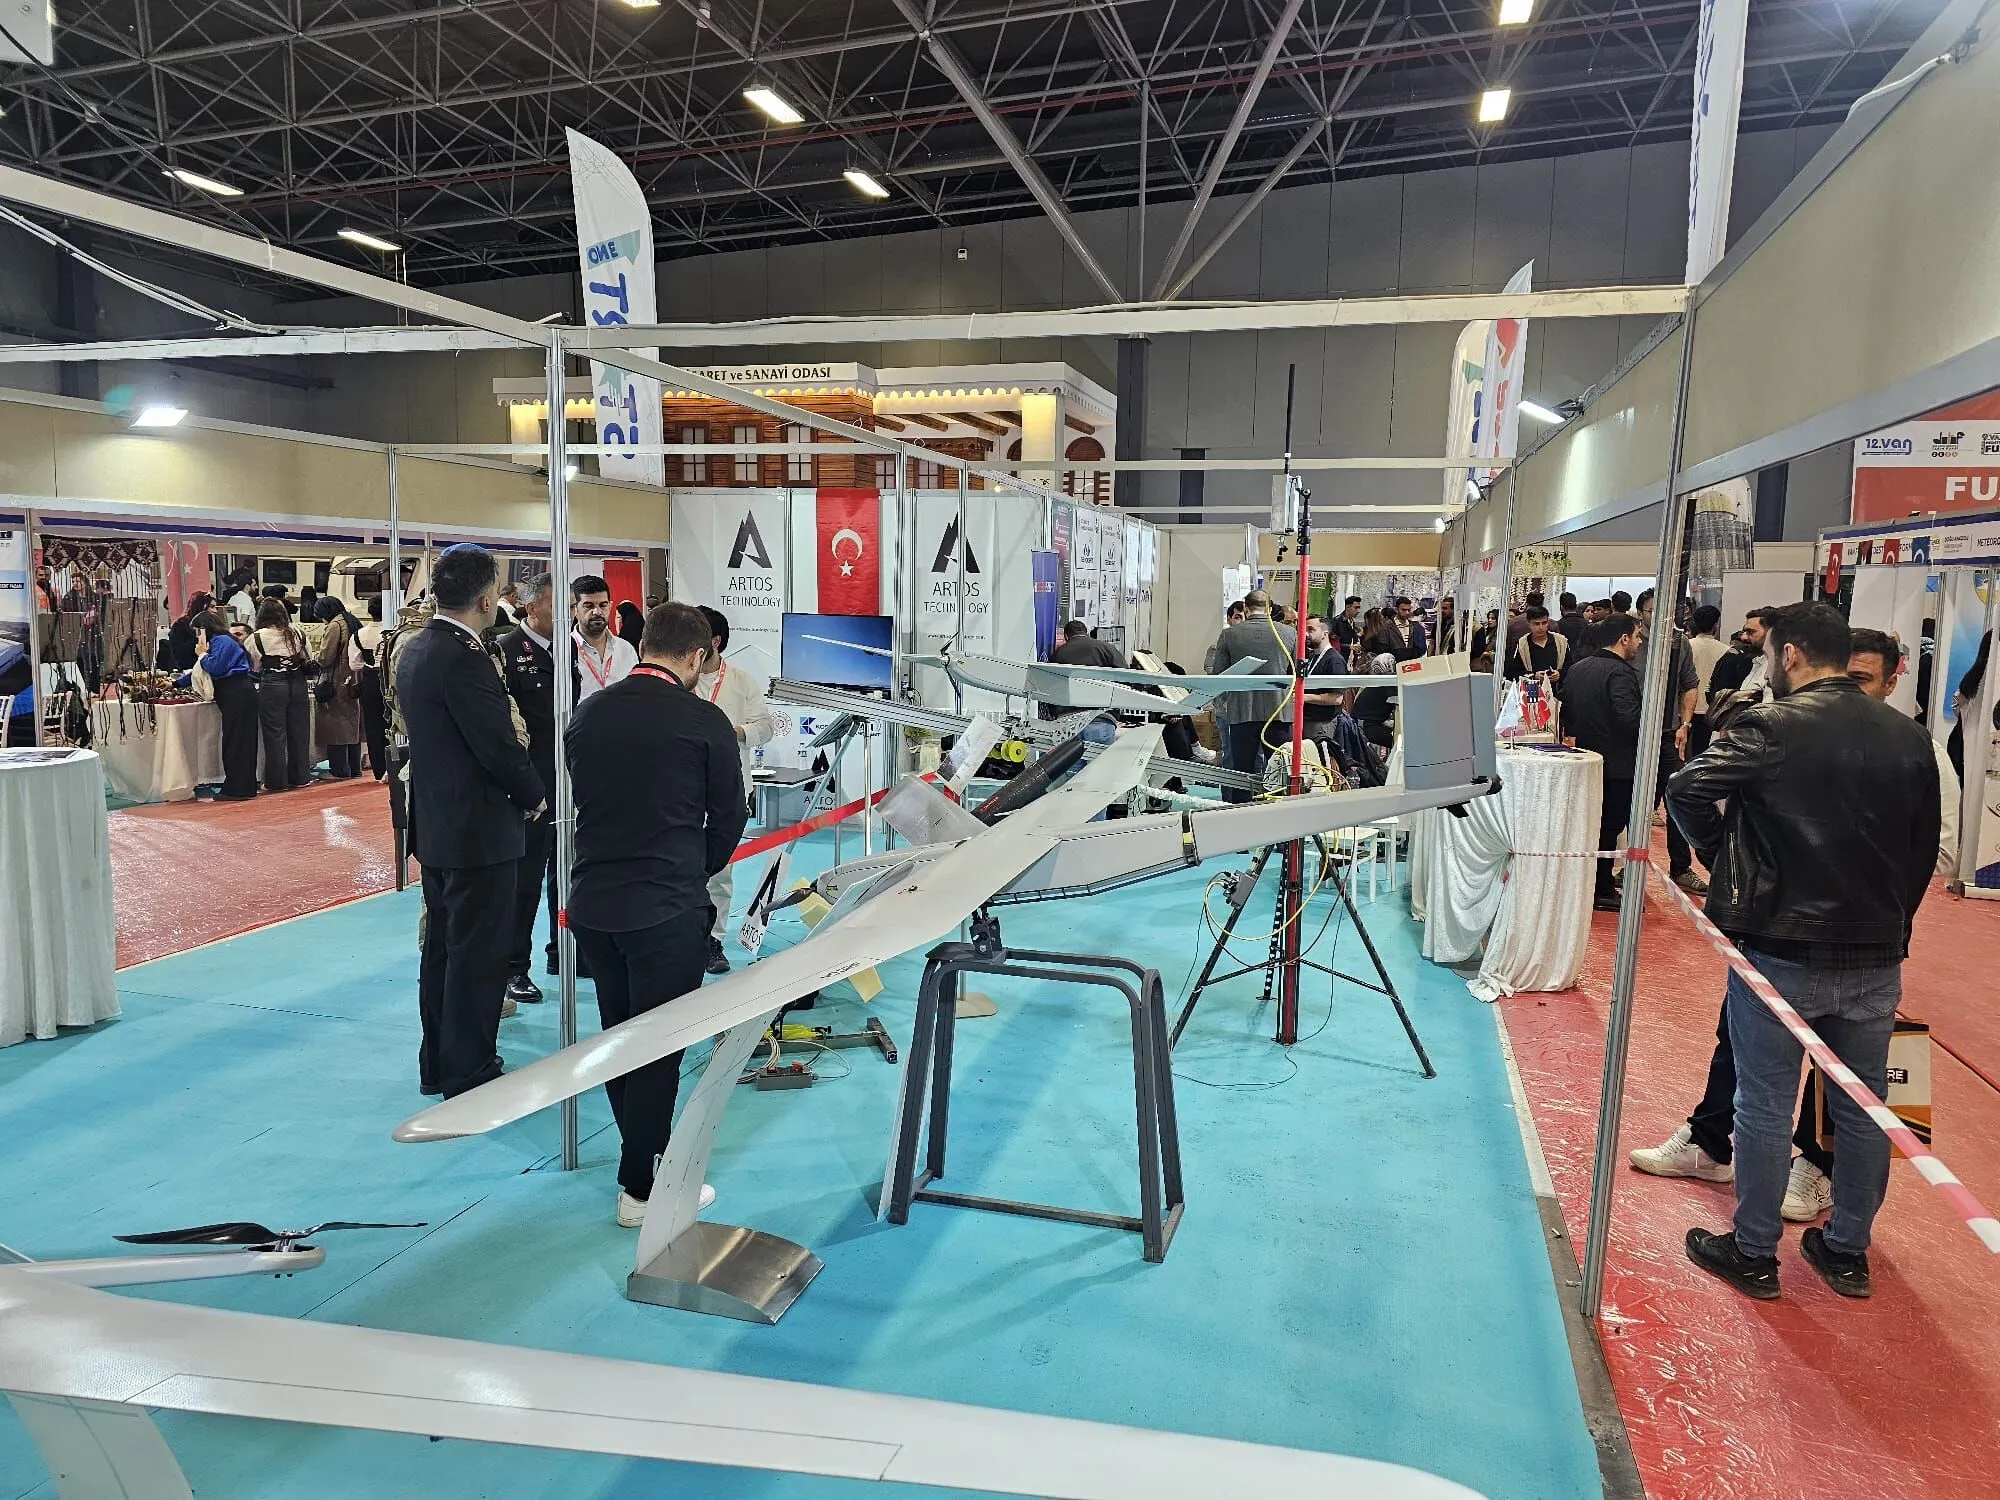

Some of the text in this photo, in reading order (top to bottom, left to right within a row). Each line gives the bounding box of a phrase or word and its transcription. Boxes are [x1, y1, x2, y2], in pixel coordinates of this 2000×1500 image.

[730, 372, 743, 381] ve
[745, 366, 788, 380] SANAYİ
[792, 367, 831, 379] ODASI
[1945, 476, 2000, 501] FU
[729, 576, 773, 591] ARTOS
[721, 595, 781, 608] TECHNOLOGY
[924, 601, 989, 614] TECHNOGY
